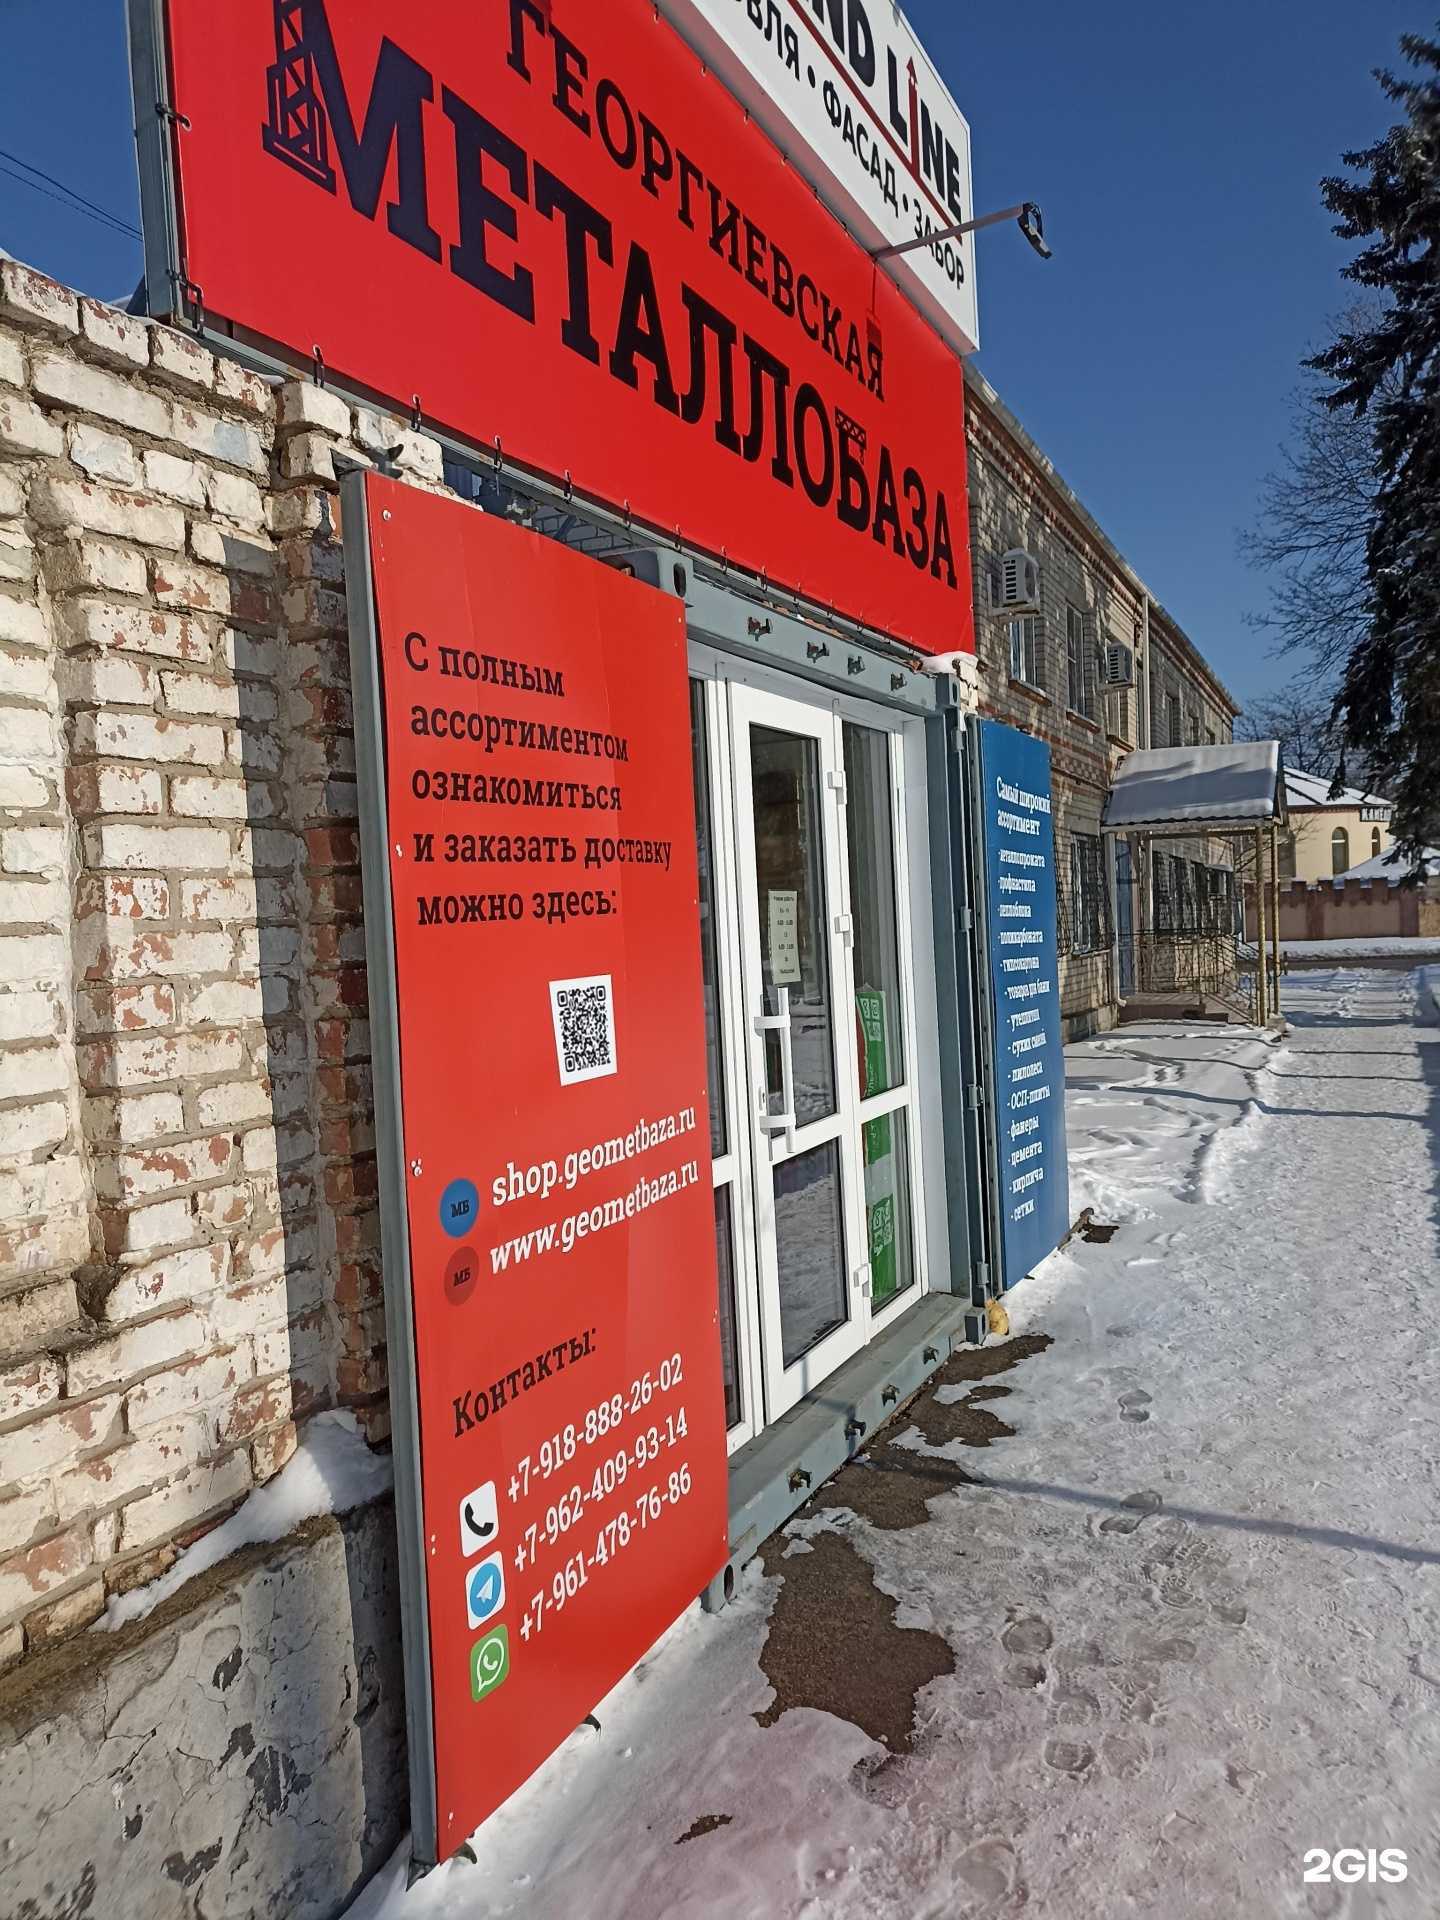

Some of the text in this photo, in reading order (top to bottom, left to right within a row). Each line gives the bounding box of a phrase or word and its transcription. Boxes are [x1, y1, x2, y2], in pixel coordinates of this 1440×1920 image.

[822, 80, 900, 218] ФАСАД
[887, 44, 963, 223] LINE
[506, 0, 885, 403] ГЕОРГИЕВСКАЯ
[261, 0, 958, 590] МЕТАЛЛОБАЗА
[404, 632, 565, 697] С полным
[410, 705, 630, 762] ассортиментом
[411, 769, 623, 811] ознакомиться
[413, 833, 672, 872] и заказать доставку
[417, 889, 618, 925] можно здесь:
[492, 1106, 696, 1206] shop.geometbaza.ru
[1011, 1141, 1042, 1168] цемента
[1012, 1167, 1044, 1193] кирпича
[490, 1160, 699, 1275] www.geometbaza.ru
[453, 1327, 597, 1437] Контакты:
[507, 1352, 684, 1503] +7-918-888-26-02
[514, 1406, 688, 1572] +7-962-409-93-14
[519, 1462, 693, 1642] +7-961-478-76-86
